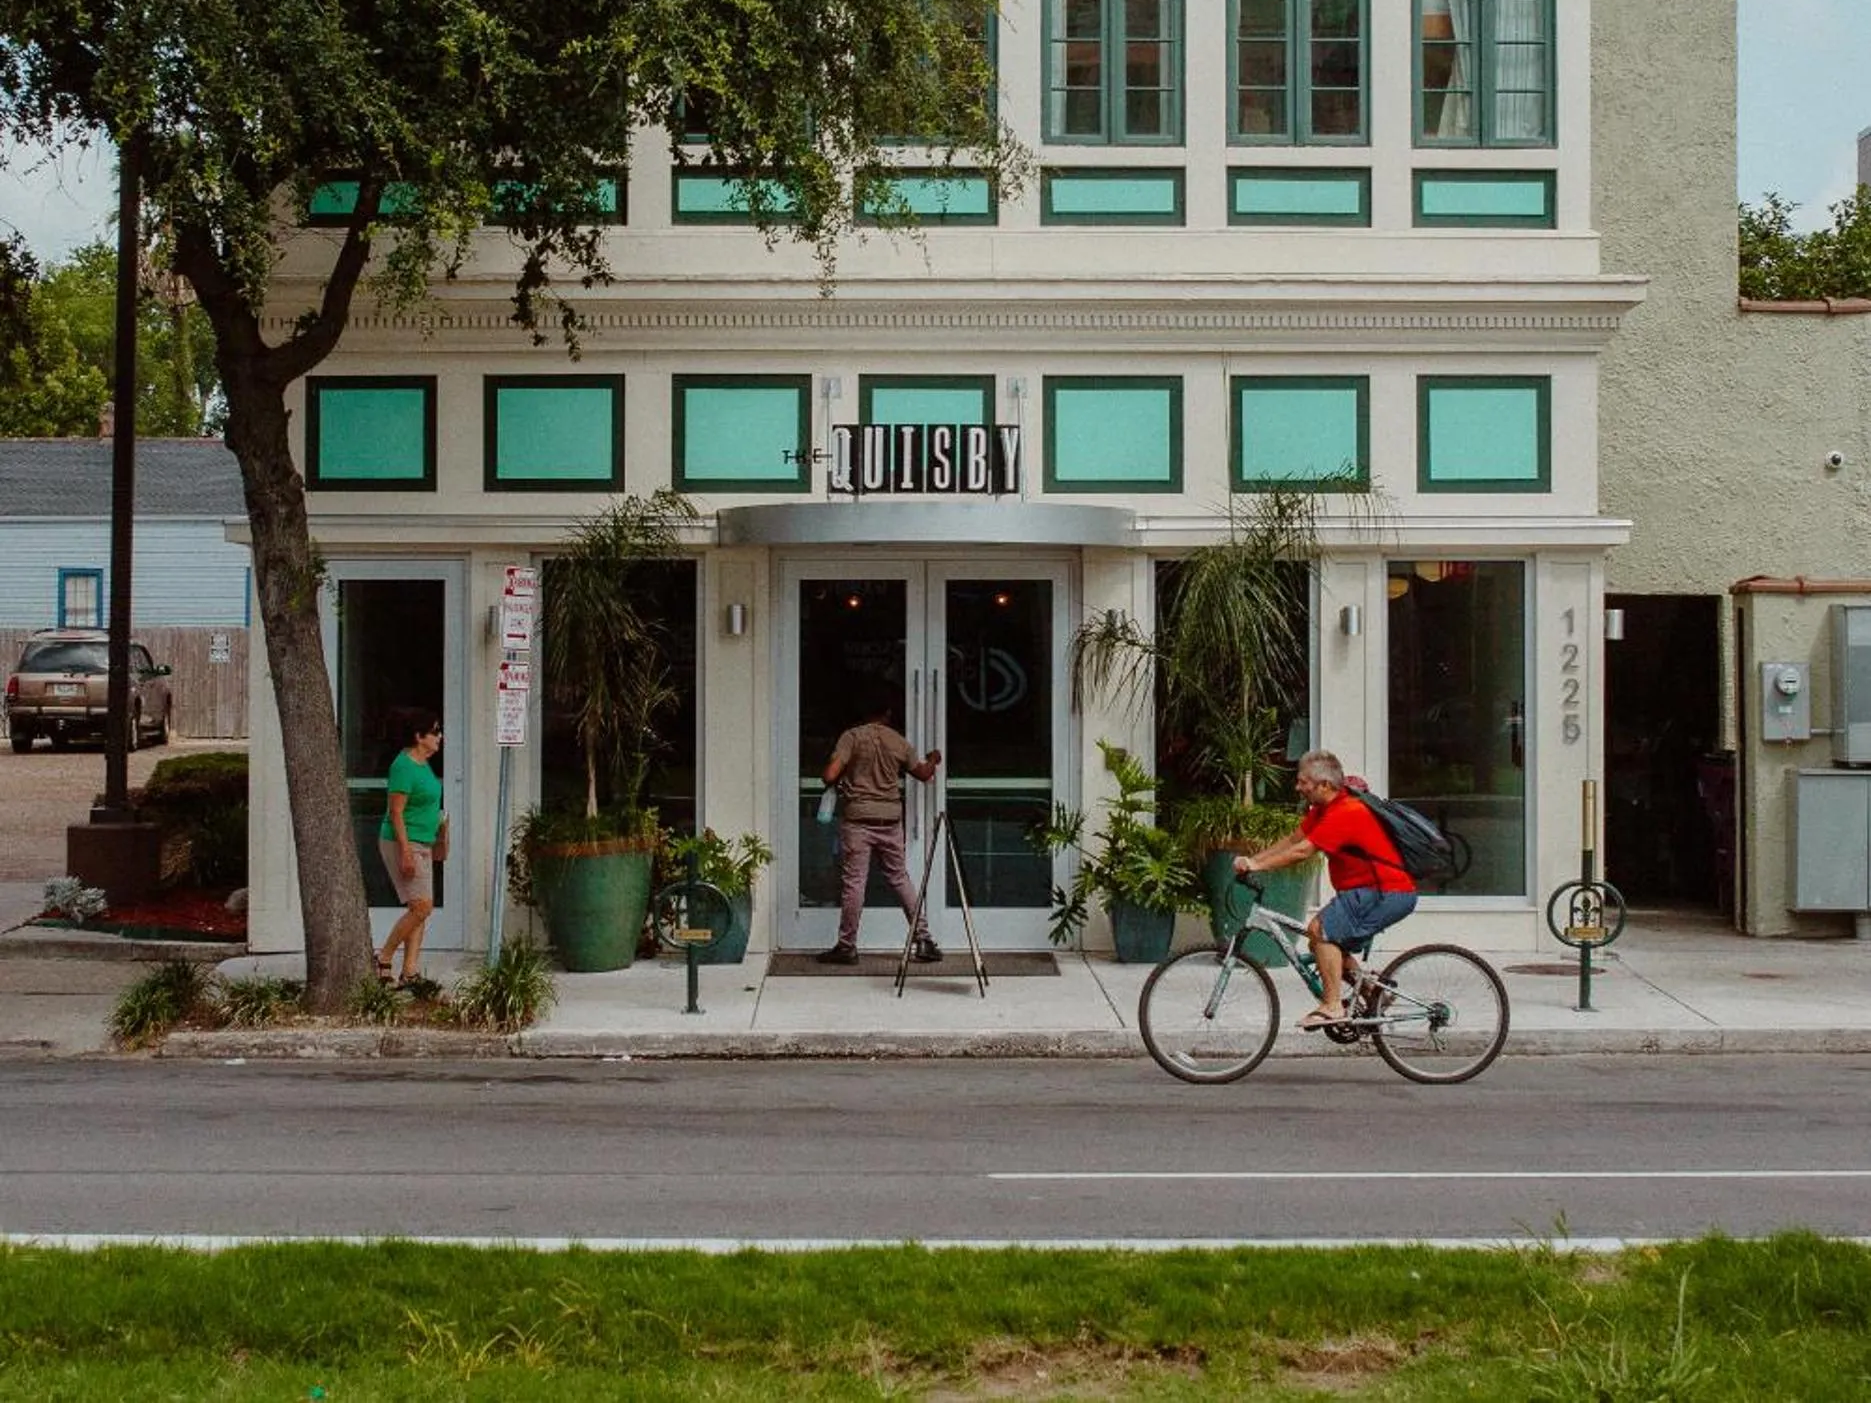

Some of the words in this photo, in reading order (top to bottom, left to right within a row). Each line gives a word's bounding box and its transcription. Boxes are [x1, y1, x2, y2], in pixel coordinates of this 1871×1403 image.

[782, 448, 822, 464] THE
[831, 426, 1020, 491] QUISBY
[1560, 606, 1581, 745] 1225
